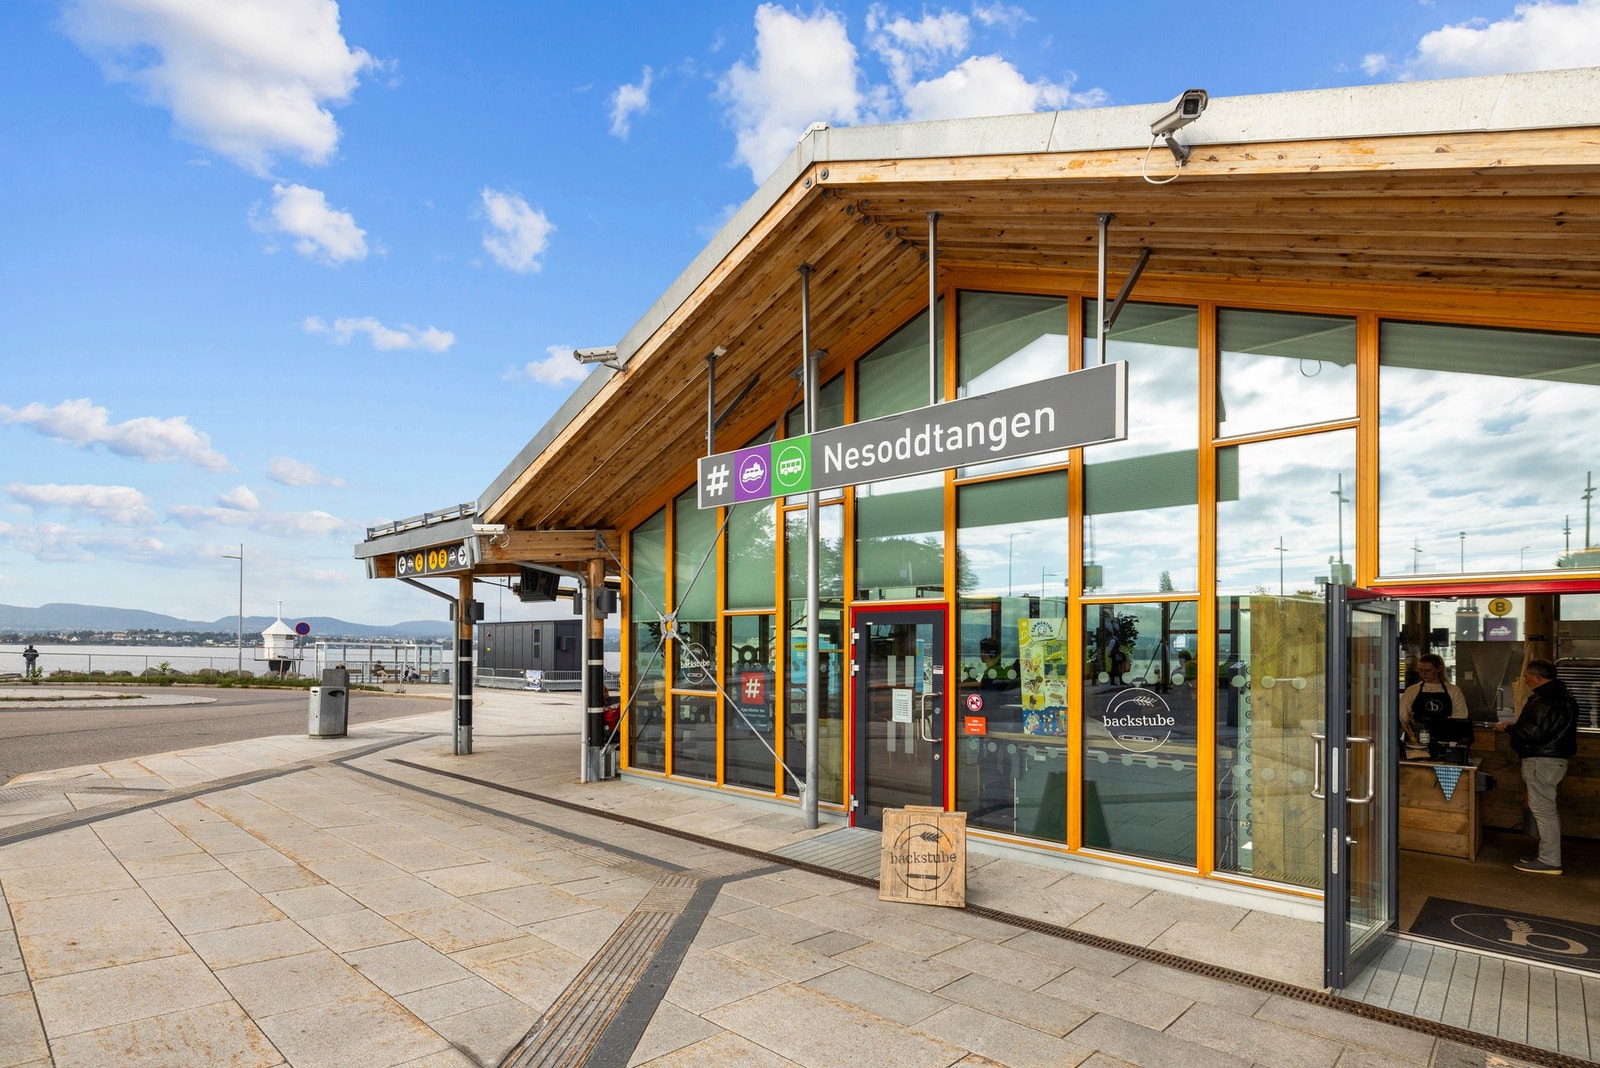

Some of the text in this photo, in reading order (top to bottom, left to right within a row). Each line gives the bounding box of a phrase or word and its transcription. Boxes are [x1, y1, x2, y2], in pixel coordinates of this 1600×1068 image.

[824, 406, 1056, 474] Nesoddtangen
[1495, 601, 1506, 613] B
[1102, 713, 1175, 727] backstube
[890, 850, 957, 865] backstube
